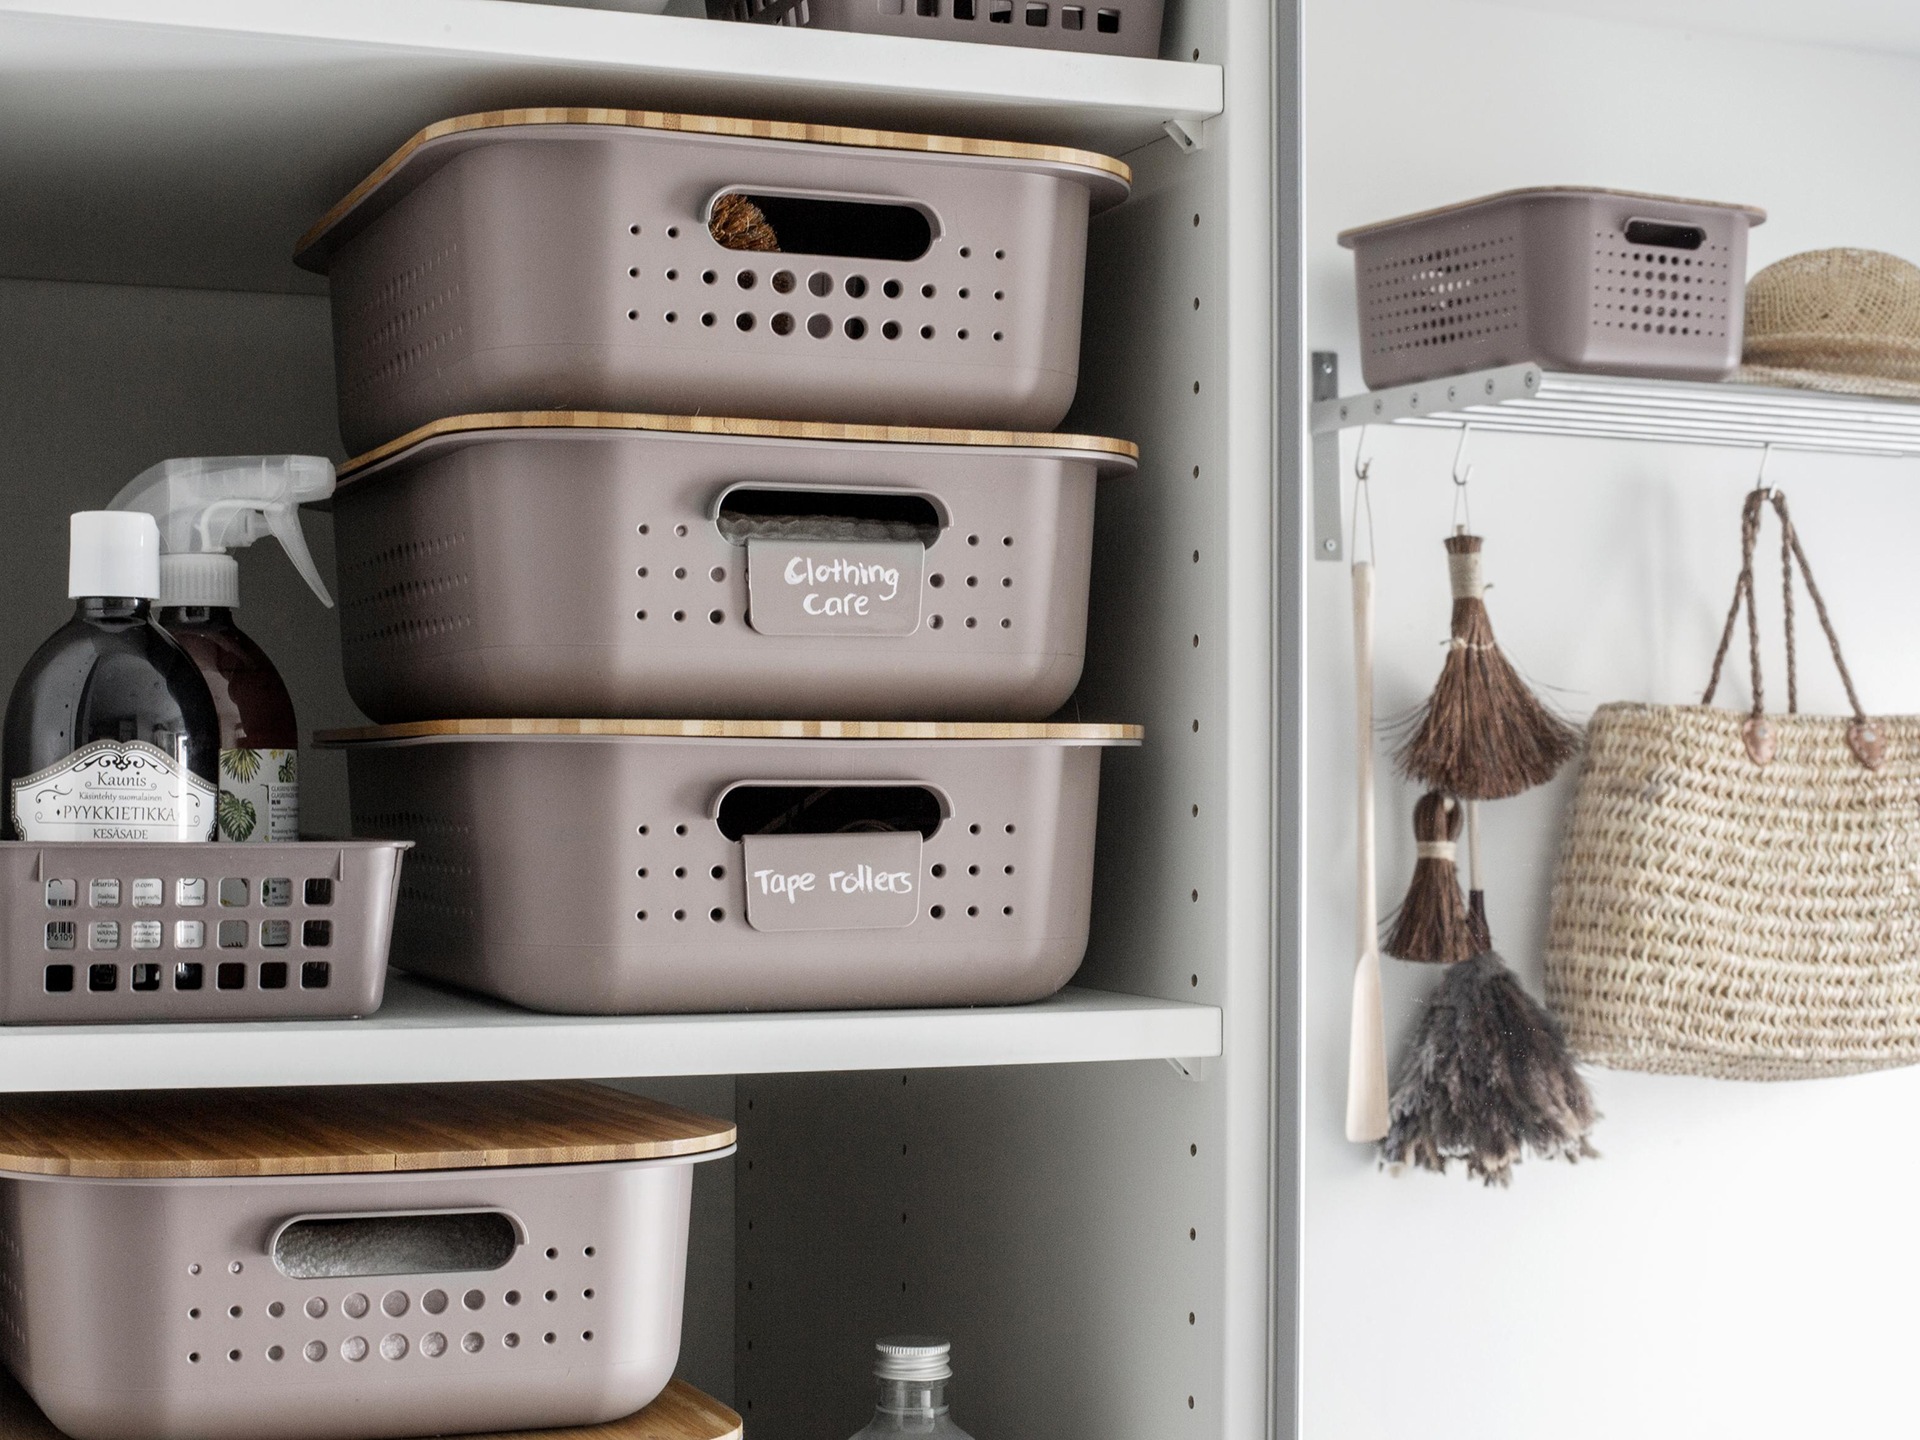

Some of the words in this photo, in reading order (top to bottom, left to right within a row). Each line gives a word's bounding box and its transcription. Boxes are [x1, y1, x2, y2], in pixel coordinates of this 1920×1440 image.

[784, 556, 900, 601] Clothing
[97, 771, 147, 787] Kaunis
[63, 805, 176, 821] PYYKKIETIKKA
[93, 826, 149, 840] KESÄSADE
[754, 869, 816, 904] Tape
[828, 864, 913, 894] rollers
